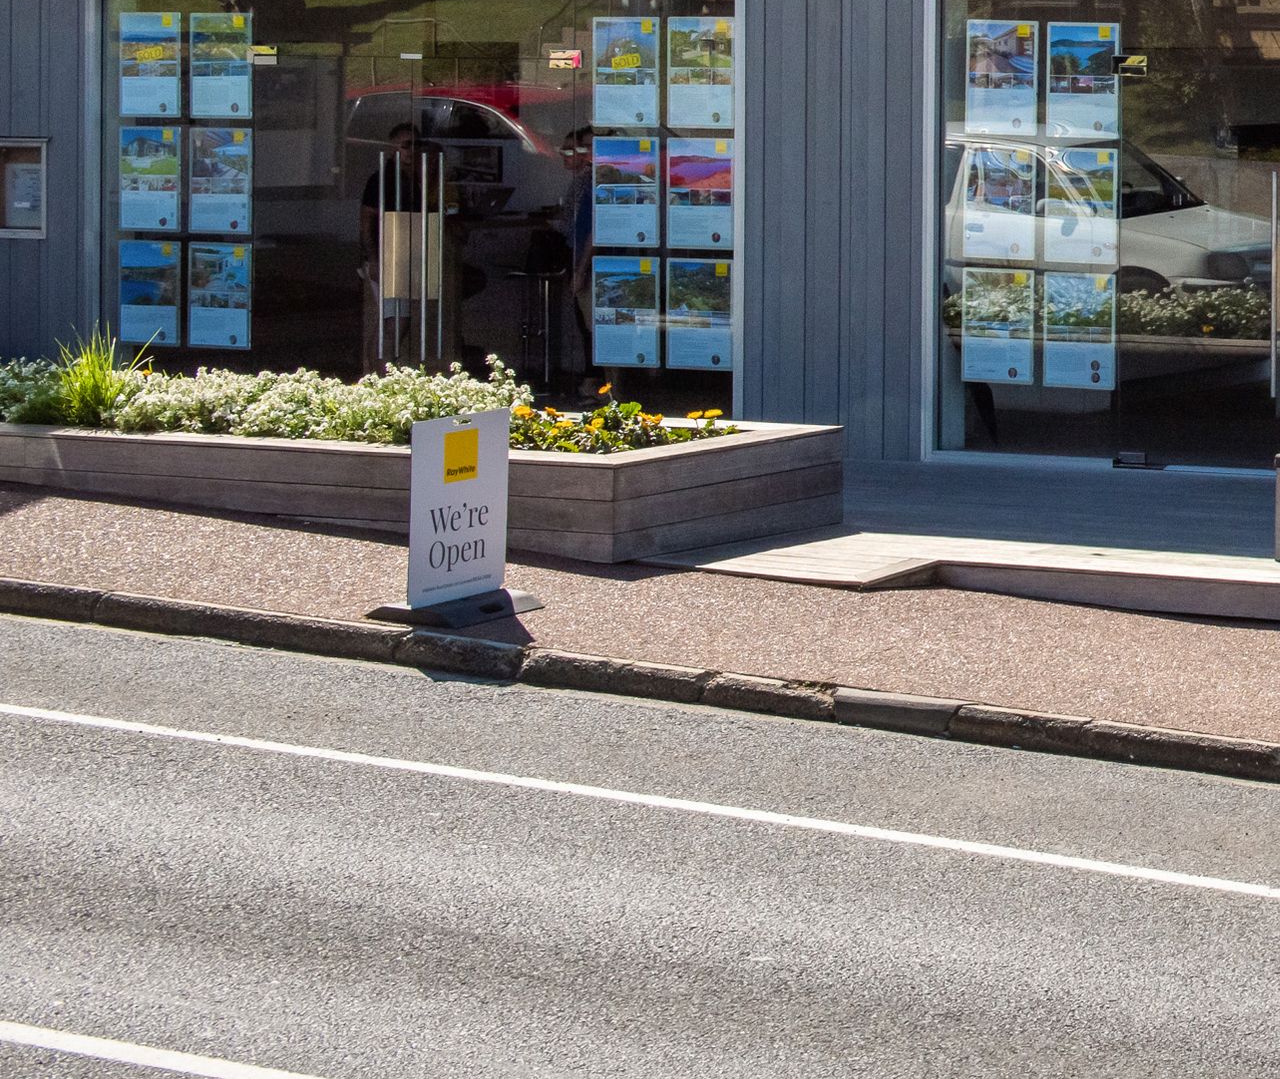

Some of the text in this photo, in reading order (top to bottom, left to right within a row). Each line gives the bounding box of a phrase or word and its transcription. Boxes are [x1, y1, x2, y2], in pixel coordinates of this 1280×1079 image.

[613, 54, 640, 68] SOLD
[430, 502, 489, 535] We're
[429, 538, 486, 572] Open
